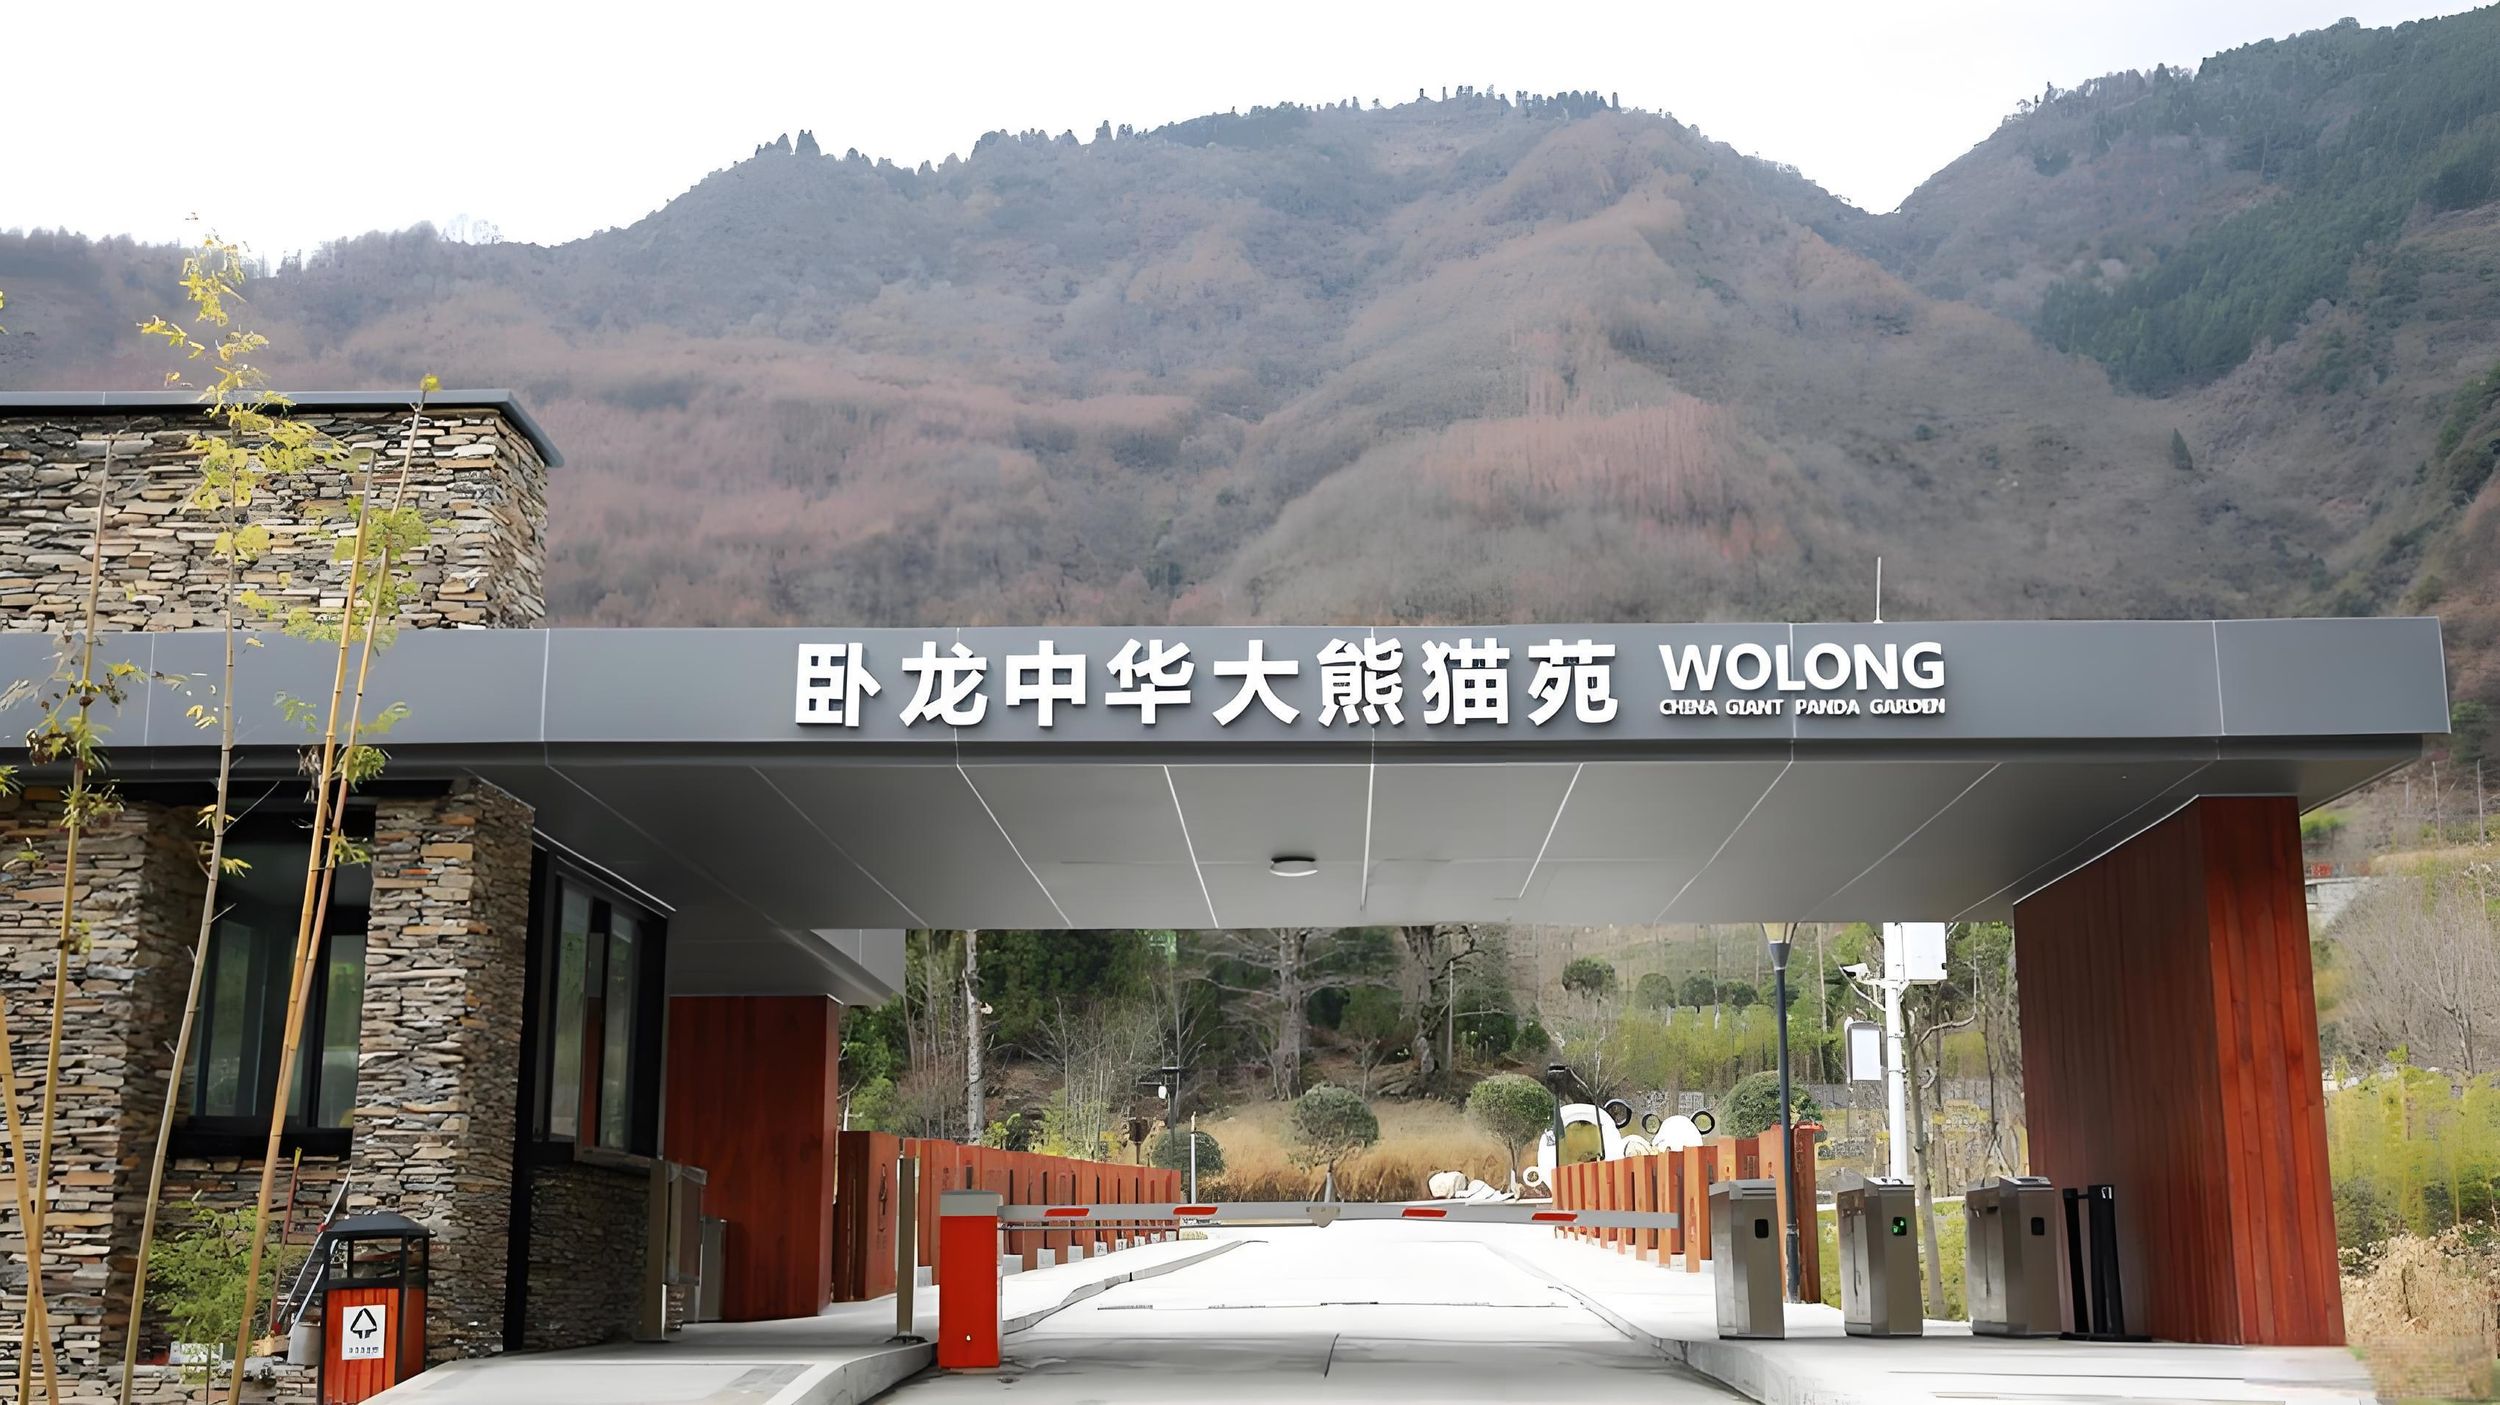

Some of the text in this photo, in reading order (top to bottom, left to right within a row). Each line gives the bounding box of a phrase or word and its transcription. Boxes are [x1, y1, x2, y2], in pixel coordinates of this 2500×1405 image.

[795, 637, 1618, 727] 卧龙中华大熊猫苑
[1658, 641, 1946, 691] WOLONG
[1659, 698, 1946, 715] CHINA GIANT PANDA GARDEN
